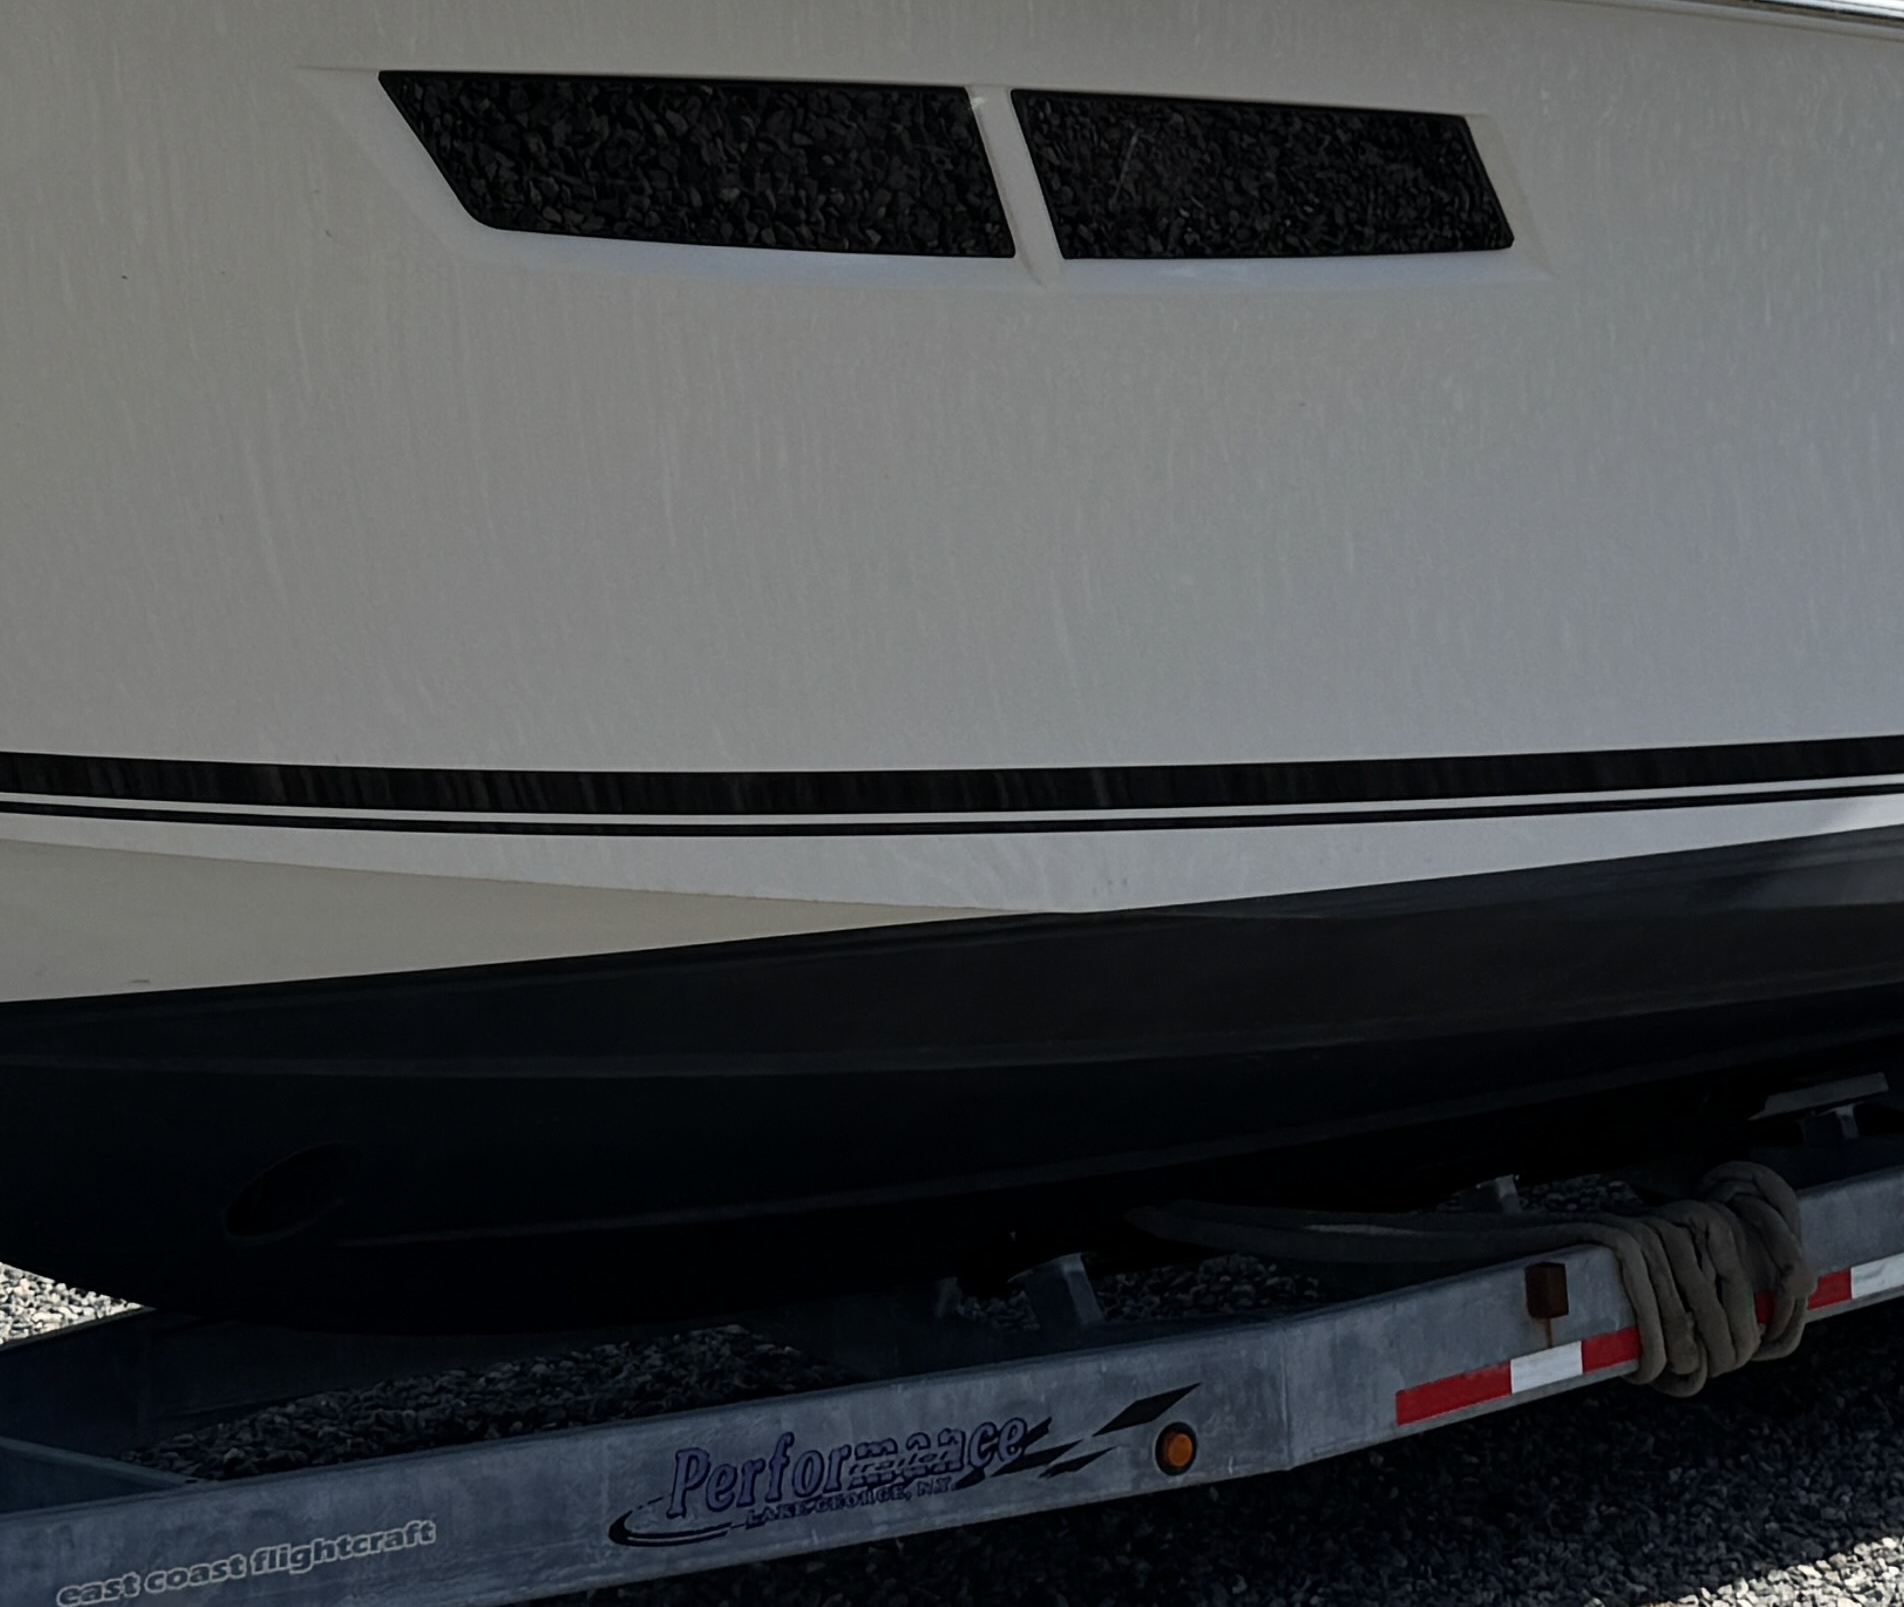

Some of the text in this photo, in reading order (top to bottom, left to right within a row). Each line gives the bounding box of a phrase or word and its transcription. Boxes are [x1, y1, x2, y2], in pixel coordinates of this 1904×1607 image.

[667, 1417, 1028, 1517] Performance
[56, 1519, 437, 1607] east coast flightcraft
